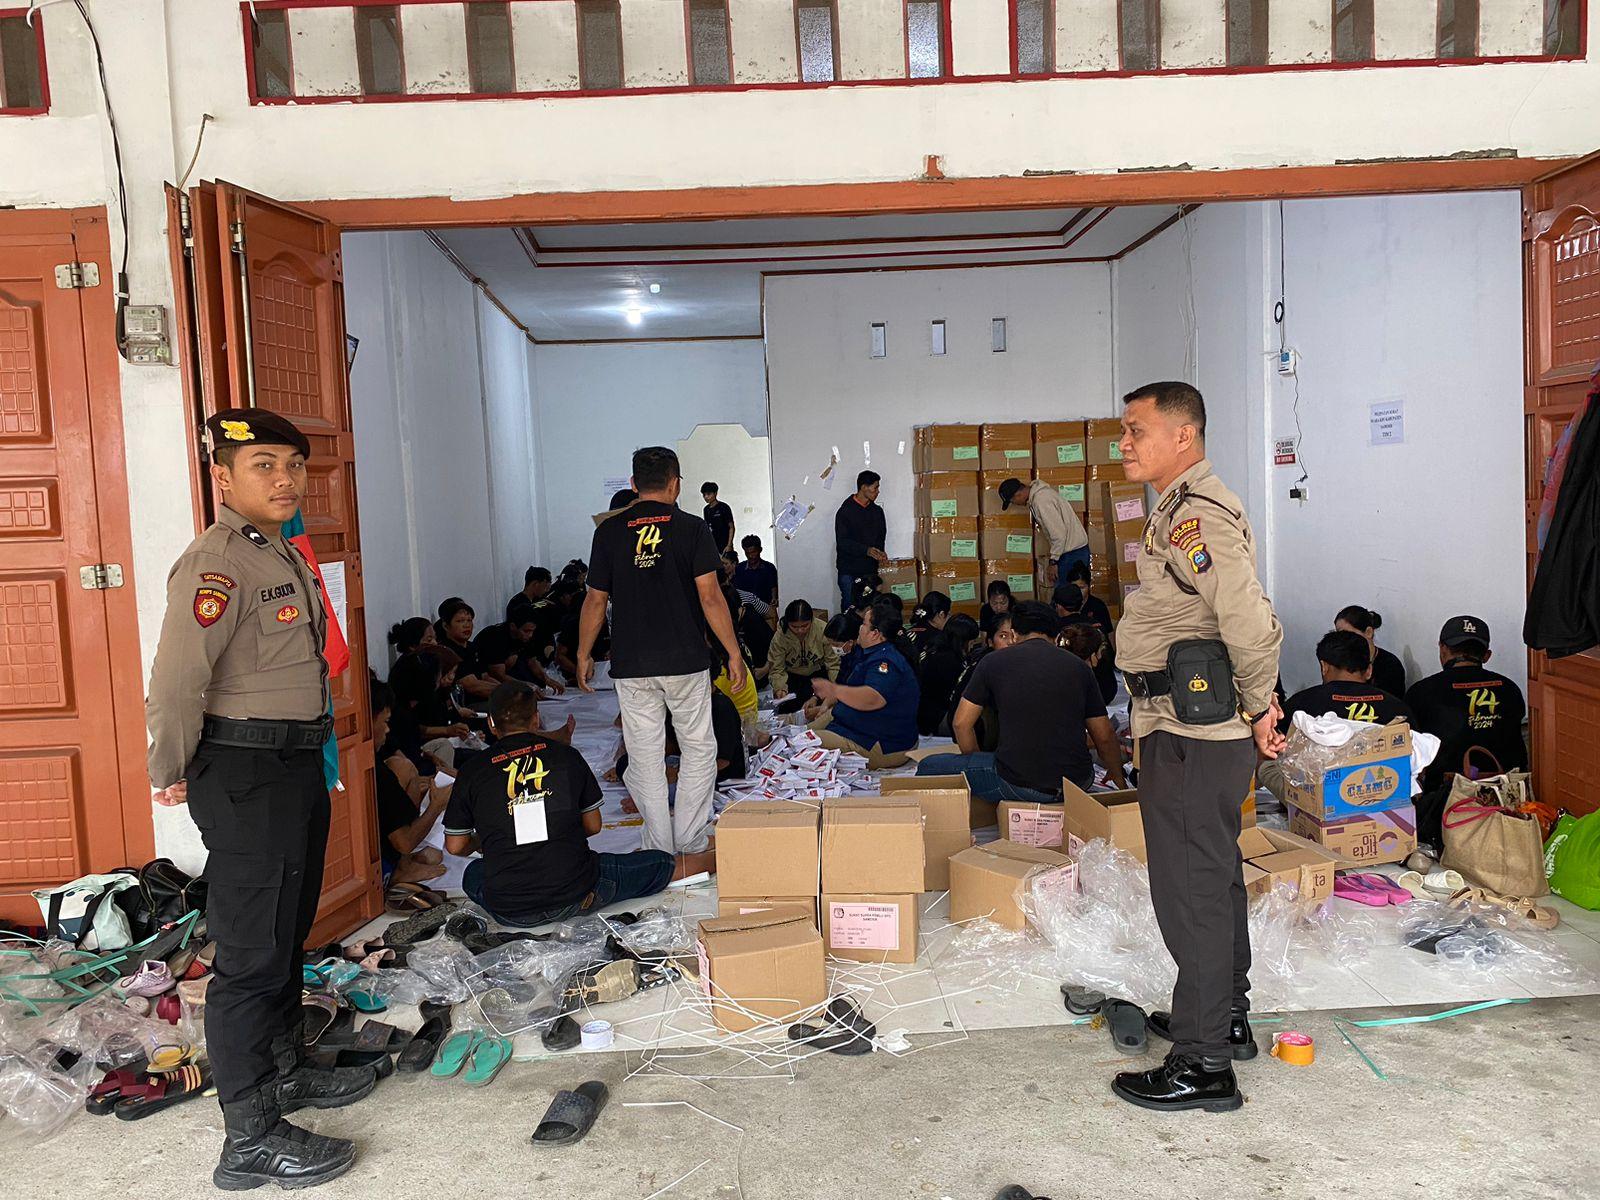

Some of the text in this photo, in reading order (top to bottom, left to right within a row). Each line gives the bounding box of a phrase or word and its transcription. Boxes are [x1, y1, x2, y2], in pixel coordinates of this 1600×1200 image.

[636, 524, 663, 555] 14
[1171, 519, 1198, 542] POLRES
[1463, 619, 1477, 633] LA
[1345, 702, 1379, 723] 14
[1466, 688, 1500, 716] 14
[503, 755, 550, 800] 14
